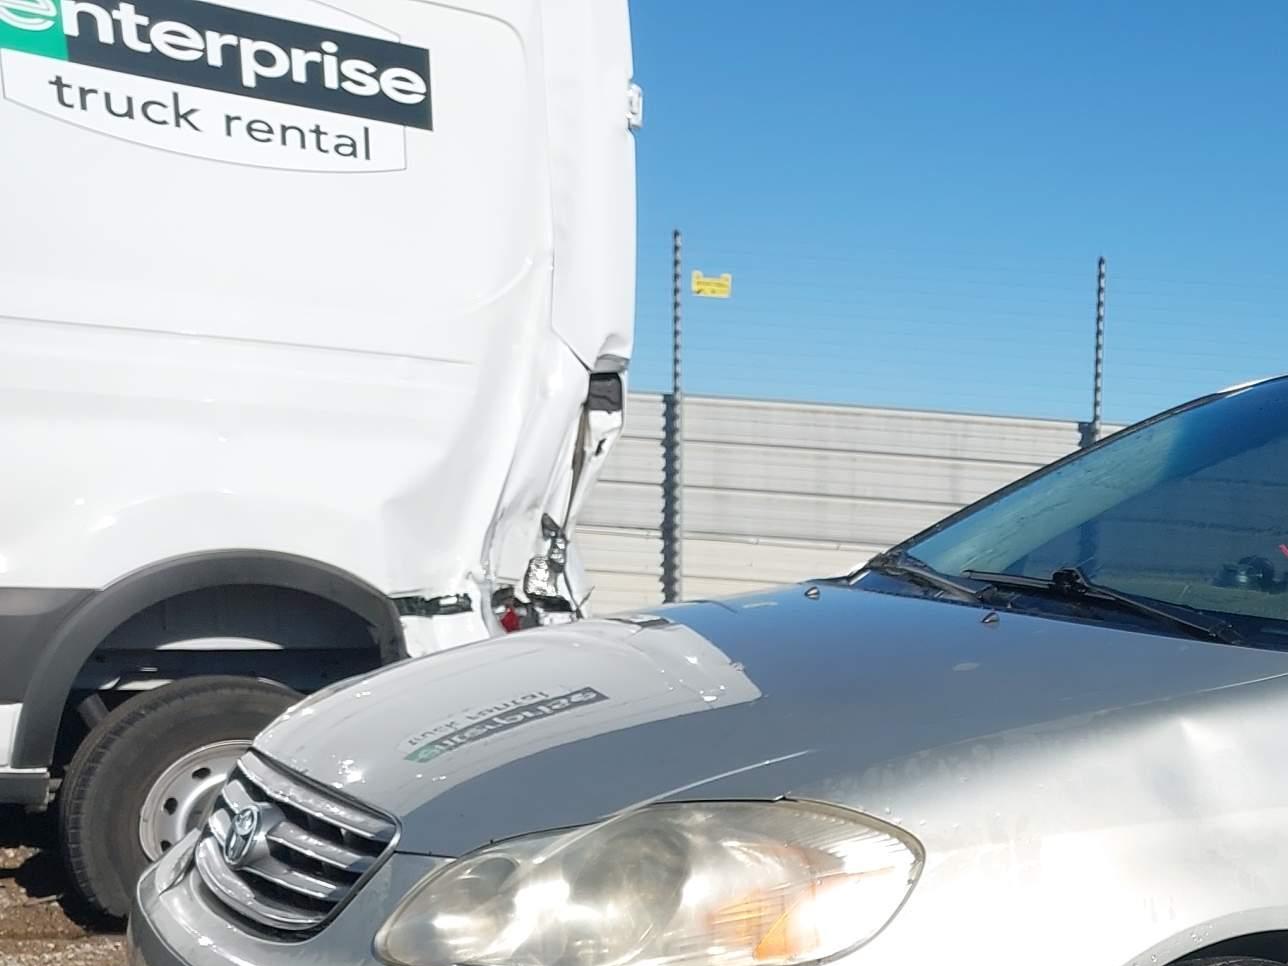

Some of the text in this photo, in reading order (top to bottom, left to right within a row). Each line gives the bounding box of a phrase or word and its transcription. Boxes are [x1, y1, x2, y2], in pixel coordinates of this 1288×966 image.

[0, 0, 427, 104] enterprise
[48, 75, 371, 161] truck rental
